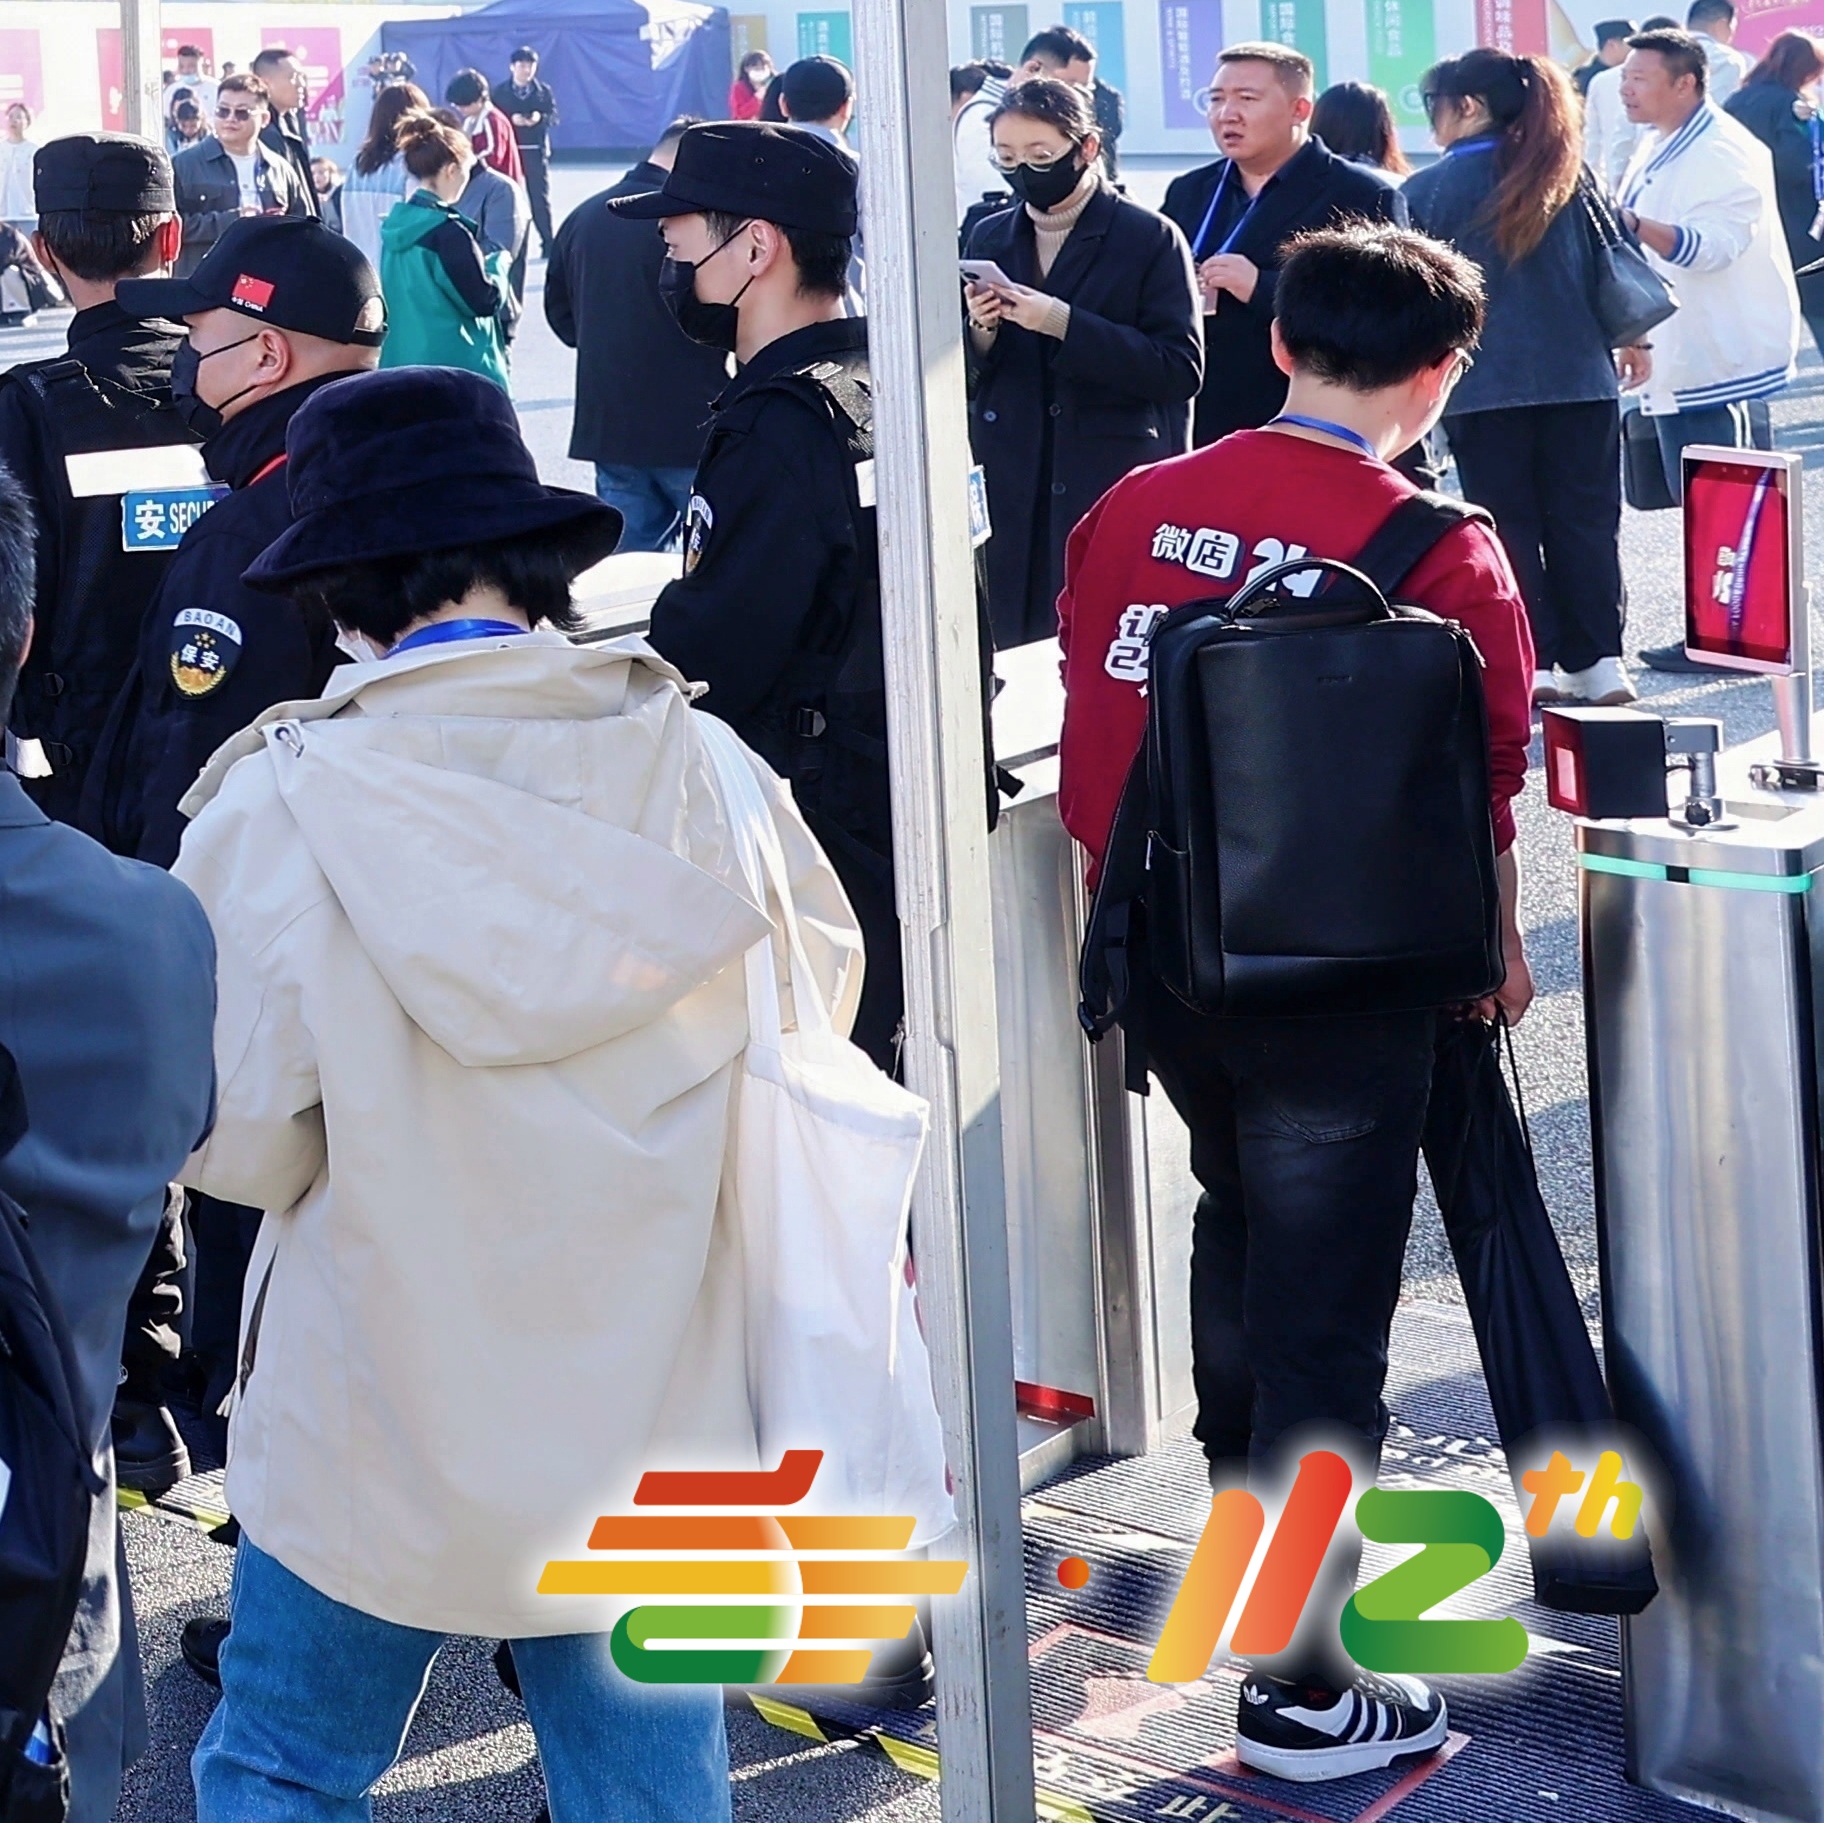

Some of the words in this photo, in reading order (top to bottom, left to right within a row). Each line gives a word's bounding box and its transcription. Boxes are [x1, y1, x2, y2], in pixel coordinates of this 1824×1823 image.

[1384, 0, 1402, 57] 休闲食品
[135, 499, 166, 541] 安
[169, 501, 219, 535] SECU
[1151, 523, 1240, 578] 微店
[181, 643, 220, 672] 保安
